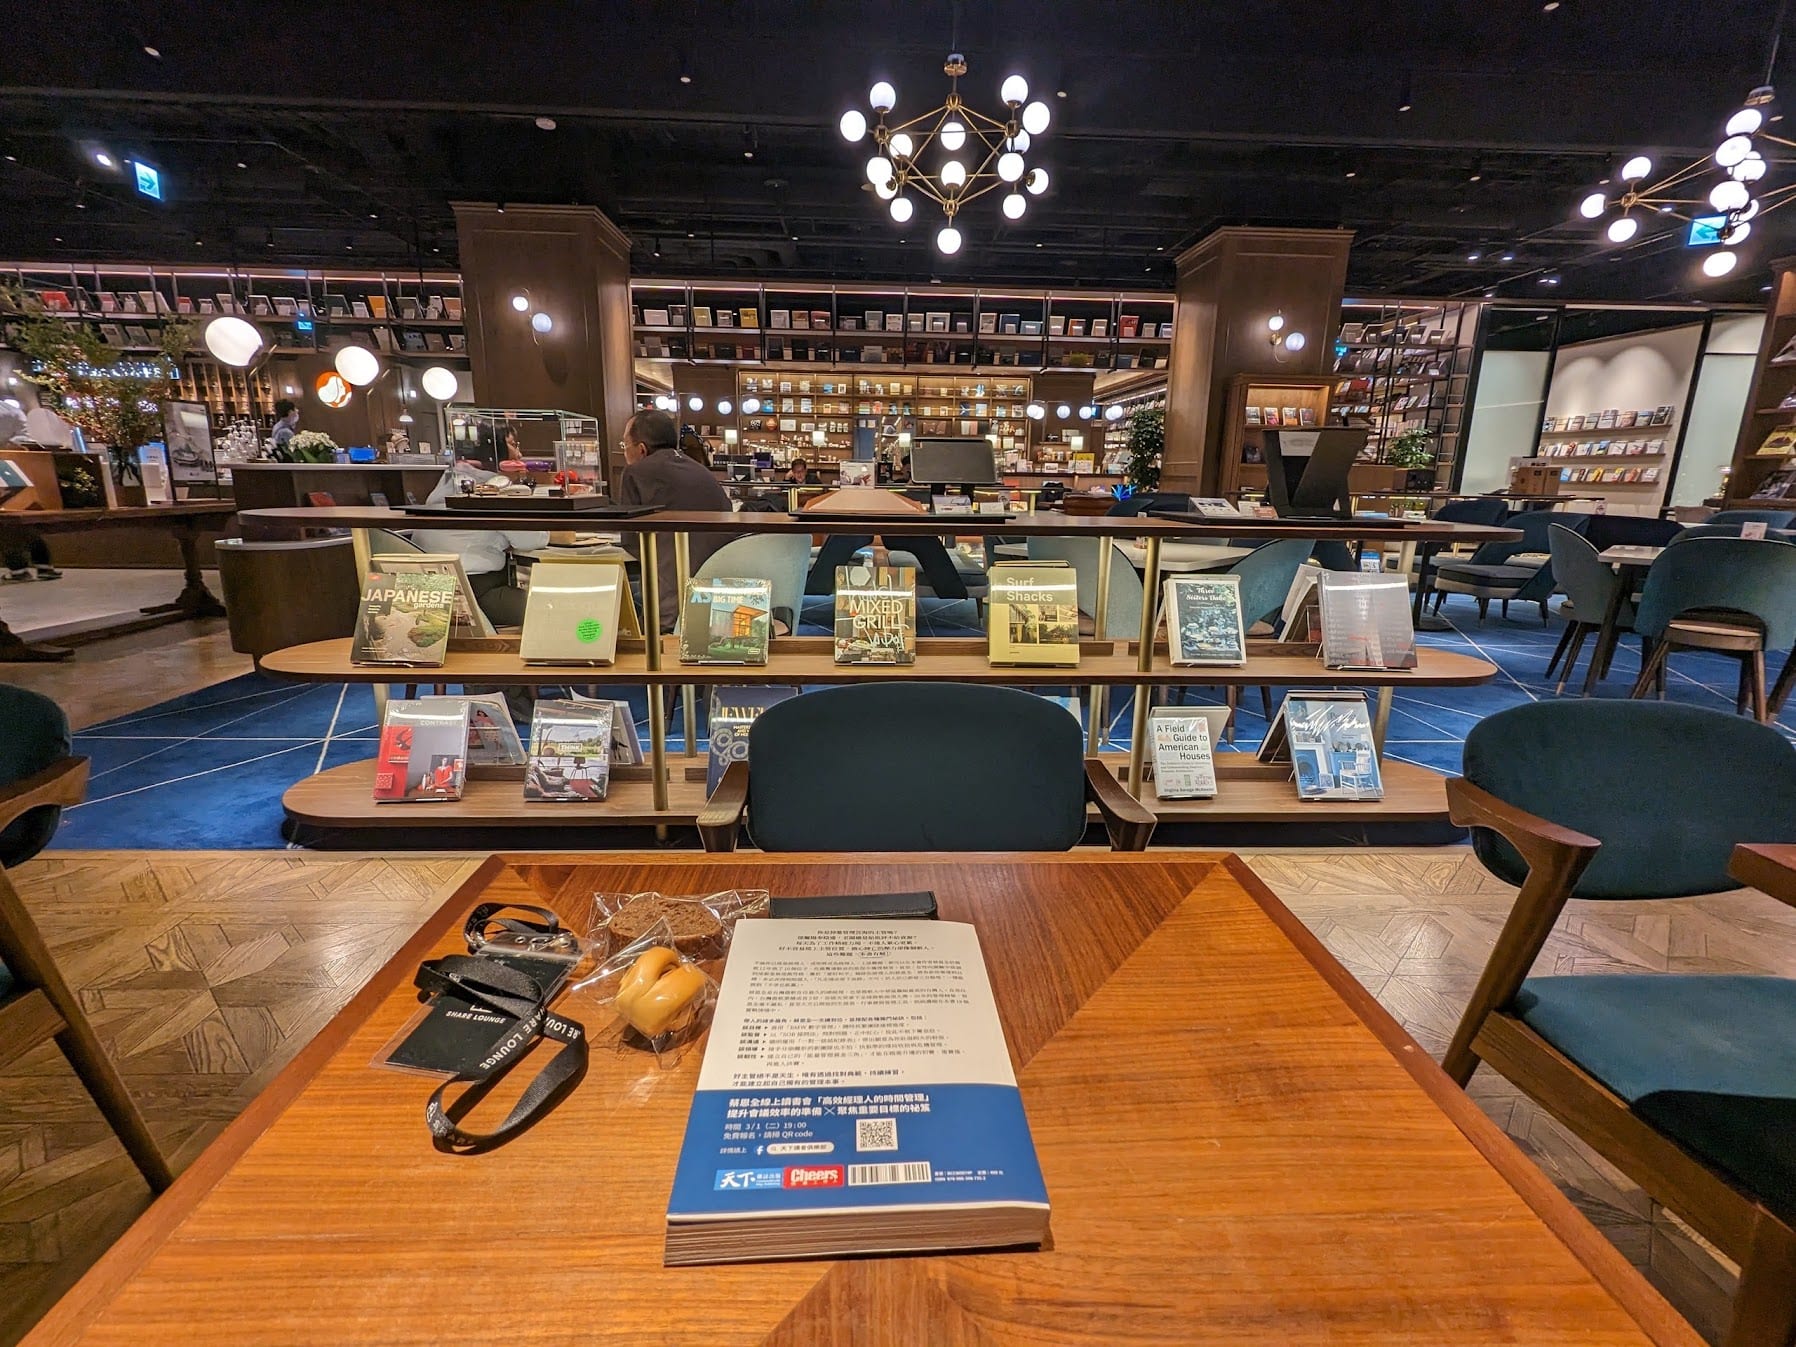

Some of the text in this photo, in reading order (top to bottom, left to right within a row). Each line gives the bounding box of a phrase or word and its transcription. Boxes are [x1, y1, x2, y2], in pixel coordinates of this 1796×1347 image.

[1006, 577, 1035, 589] Surf
[360, 589, 453, 604] JAPANESE
[1006, 591, 1054, 602] Shacks
[849, 600, 904, 614] MIXED
[853, 615, 901, 629] GRILL
[1156, 725, 1185, 733] A Field
[1173, 734, 1197, 742] Guide
[1158, 743, 1199, 751] American
[445, 1010, 507, 1024] SHARE LOUNGE
[479, 1033, 524, 1070] LOUNGE
[790, 1168, 838, 1182] Cheers
